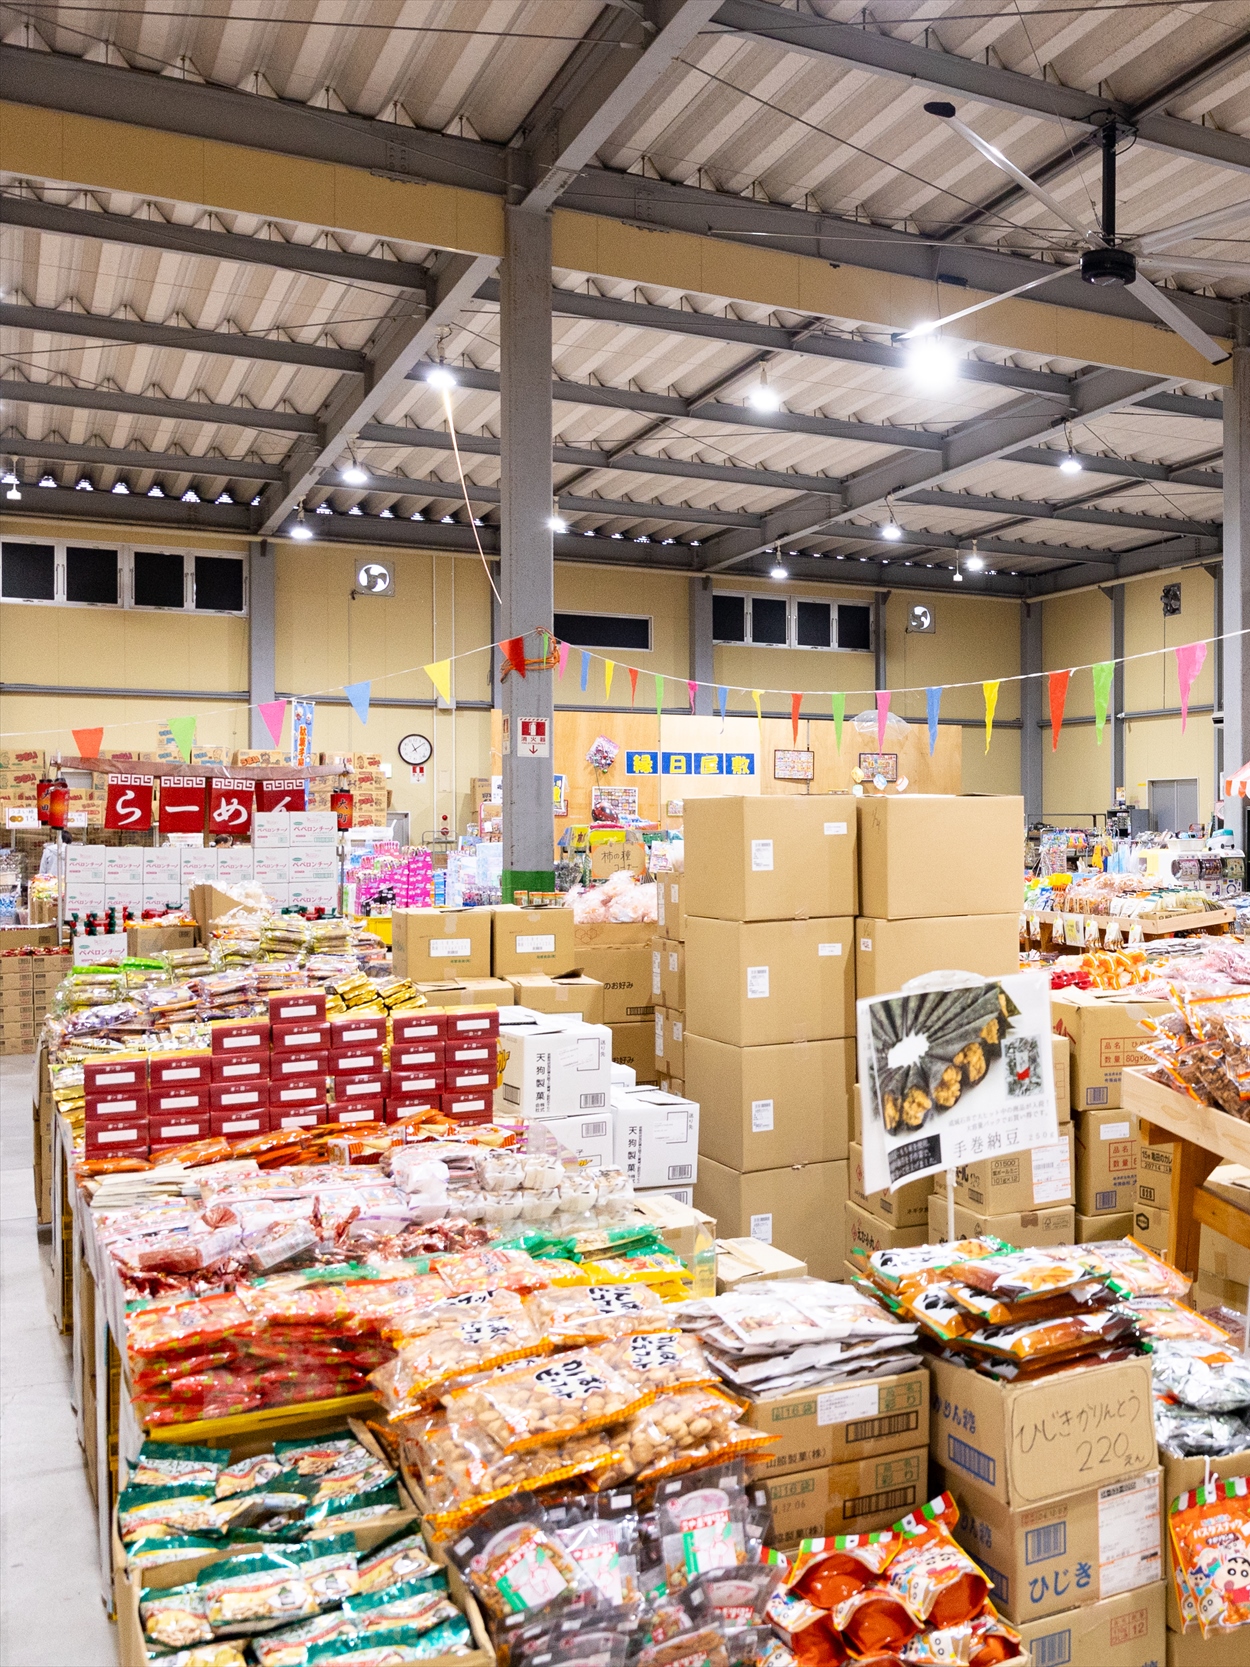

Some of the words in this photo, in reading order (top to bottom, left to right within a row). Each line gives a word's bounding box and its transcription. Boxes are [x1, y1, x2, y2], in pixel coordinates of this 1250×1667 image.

[633, 753, 751, 775] 縁日屋敷
[535, 1052, 546, 1101] 天狗製菓
[627, 1126, 638, 1174] 天狗製菓
[954, 1127, 1020, 1159] 手巻納豆
[1016, 1389, 1141, 1454] ひじきかりんとう
[1075, 1432, 1129, 1472] 220
[1124, 1452, 1146, 1467] えん
[1193, 1518, 1243, 1539] パスタスナック
[1028, 1561, 1092, 1604] ひじき
